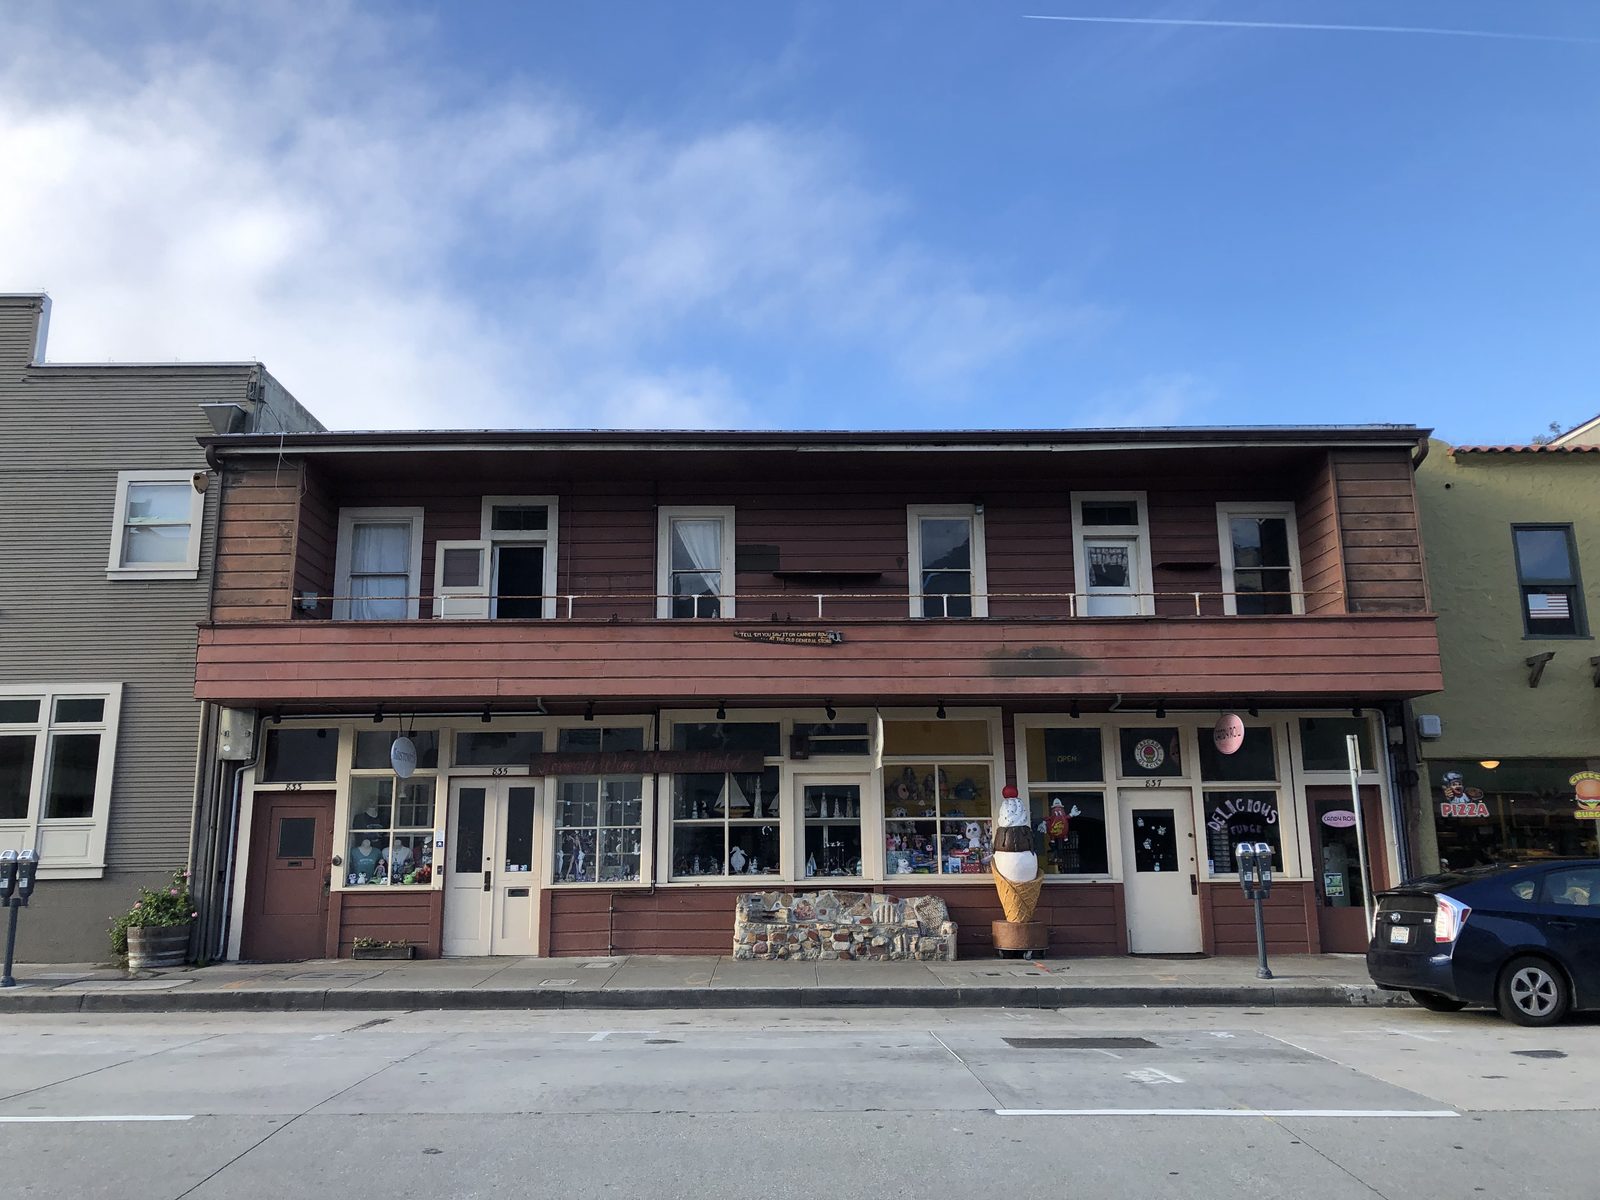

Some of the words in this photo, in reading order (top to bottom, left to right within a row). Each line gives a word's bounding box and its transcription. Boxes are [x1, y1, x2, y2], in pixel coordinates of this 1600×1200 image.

[1056, 755, 1078, 763] OPEN
[1145, 779, 1162, 788] 837
[1207, 798, 1278, 832] DELICIOUS
[1441, 802, 1489, 817] PIZZA
[1230, 824, 1262, 835] FUDGE
